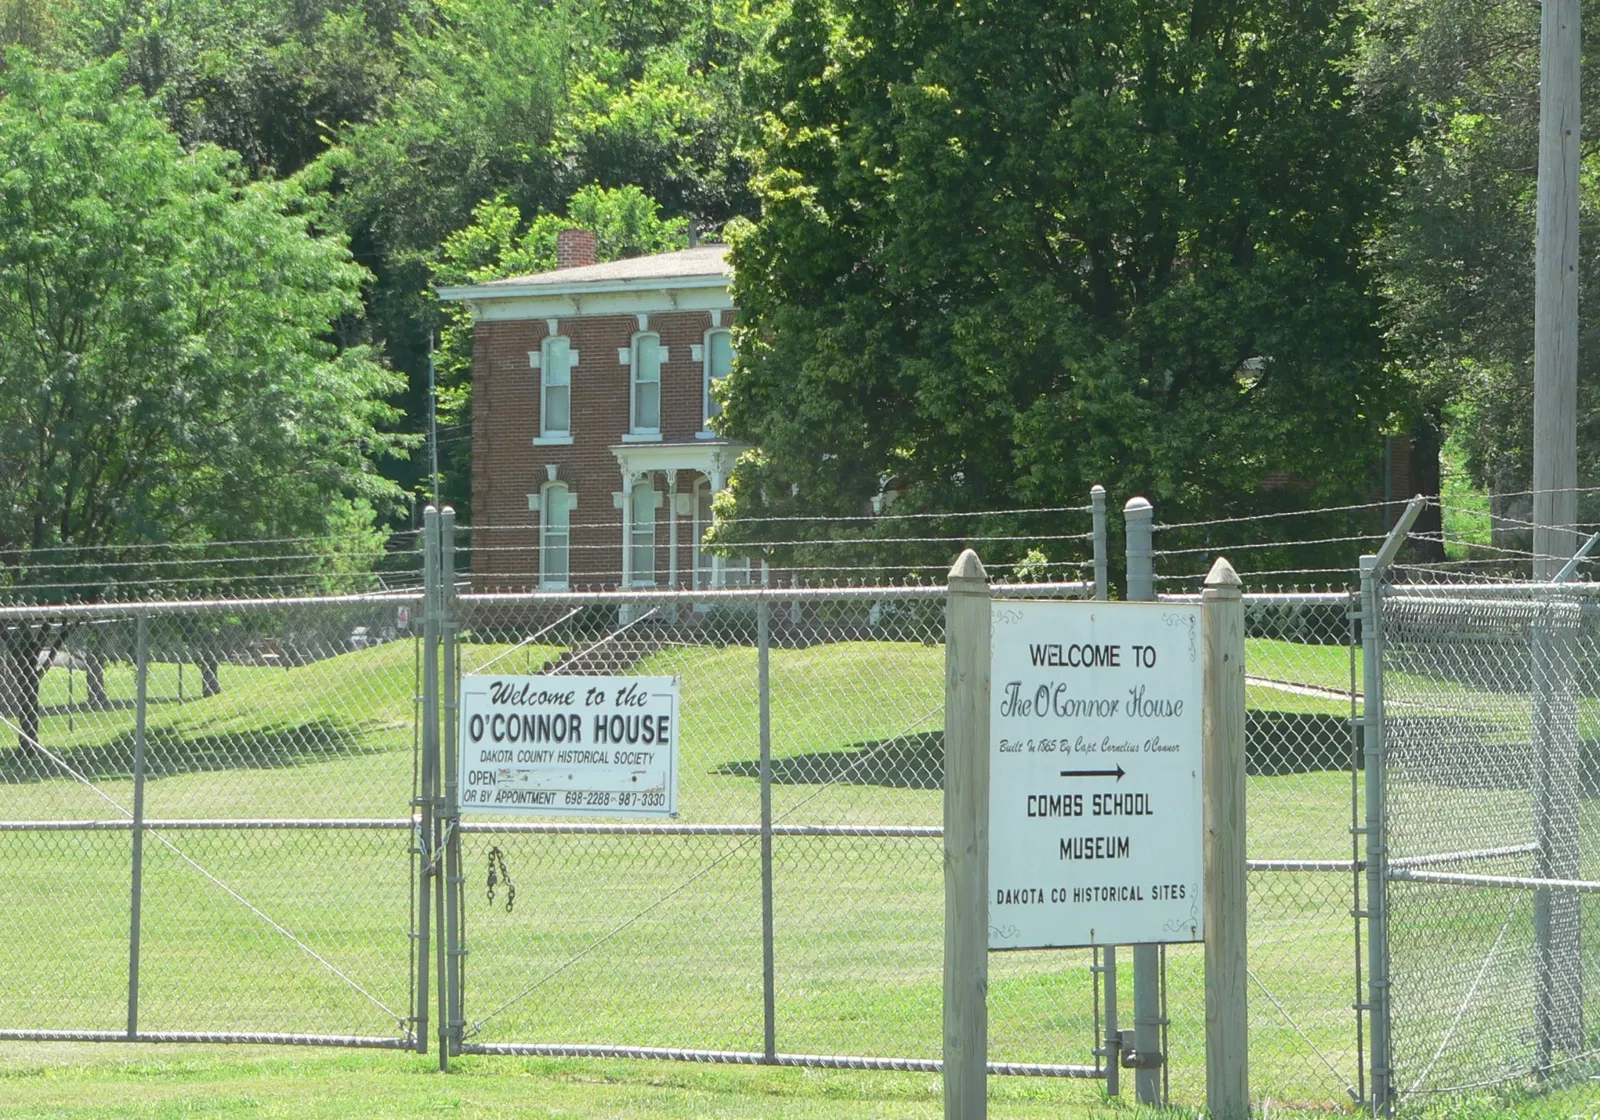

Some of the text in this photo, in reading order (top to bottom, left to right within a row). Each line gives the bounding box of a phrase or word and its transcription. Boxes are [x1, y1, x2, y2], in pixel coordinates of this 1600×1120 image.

[1030, 644, 1157, 668] WELCOME TO
[489, 680, 648, 708] Welcome to the
[1000, 680, 1184, 718] The O'Connor House
[469, 713, 670, 745] O'CONNOR HOUSE
[480, 750, 655, 765] DAKOTA COUNTY HISTORICAL SOCIETY
[999, 739, 1023, 753] Built
[1026, 739, 1036, 753] In
[1059, 738, 1072, 756] By
[1100, 735, 1140, 753] Cornelius
[1143, 735, 1180, 753] O'Connor
[468, 770, 497, 786] OPEN
[463, 789, 477, 802] OR
[480, 790, 493, 803] BY
[494, 791, 558, 805] APPOINTMENT
[565, 791, 611, 806] 698-2288
[618, 792, 666, 807] 987-3330
[1027, 793, 1154, 817] COMBS SCHOOL
[1060, 836, 1130, 860] MUSEUM
[996, 884, 1187, 905] DAKOTA CO HISTORICAL SITES
